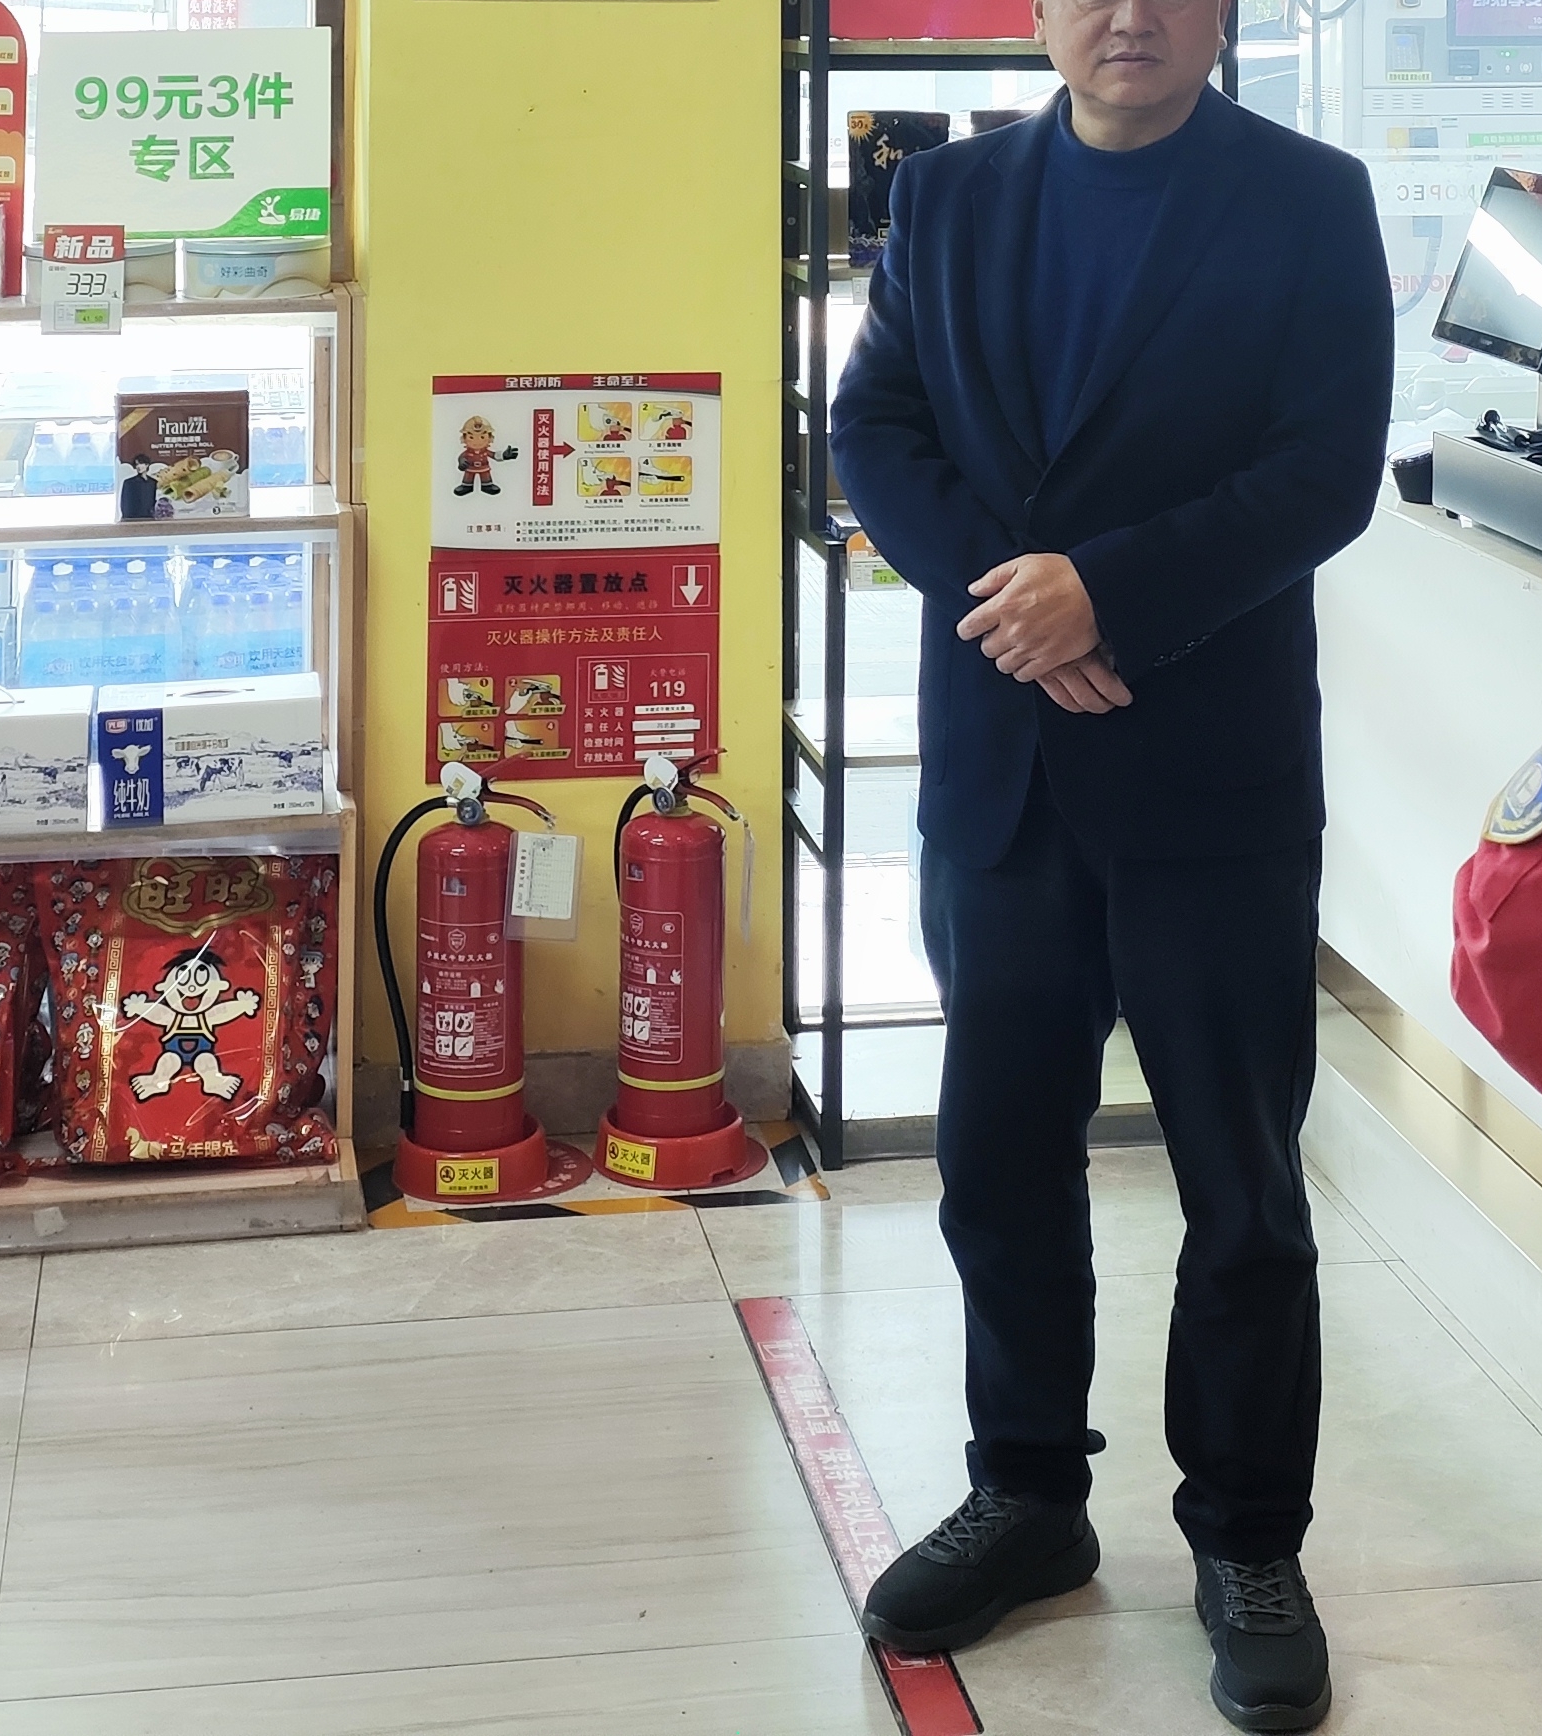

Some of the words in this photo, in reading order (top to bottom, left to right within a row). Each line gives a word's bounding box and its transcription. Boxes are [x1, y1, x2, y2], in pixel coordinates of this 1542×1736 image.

[74, 72, 295, 121] 99元3件
[129, 134, 235, 183] 专区
[288, 208, 322, 222] 易捷
[54, 235, 114, 260] 新品
[220, 266, 270, 279] 好彩曲奇
[505, 376, 561, 389] 全民消防
[593, 375, 648, 388] 生命至上
[158, 417, 208, 435] Franzzi
[536, 412, 550, 497] 灭火器使用方法
[504, 572, 649, 595] 灭火器置放点
[486, 626, 662, 646] 灭火器操作方法及责任人
[649, 681, 686, 698] 119
[584, 707, 624, 718] 灭火器
[584, 722, 624, 733] 责任人
[584, 737, 624, 748] 检查时间
[584, 752, 624, 763] 存放地点
[113, 779, 150, 813] 纯牛奶
[139, 870, 256, 914] 旺旺
[169, 1140, 239, 1160] 马年限定
[620, 1148, 651, 1167] 灭火器
[458, 1166, 494, 1181] 灭火器
